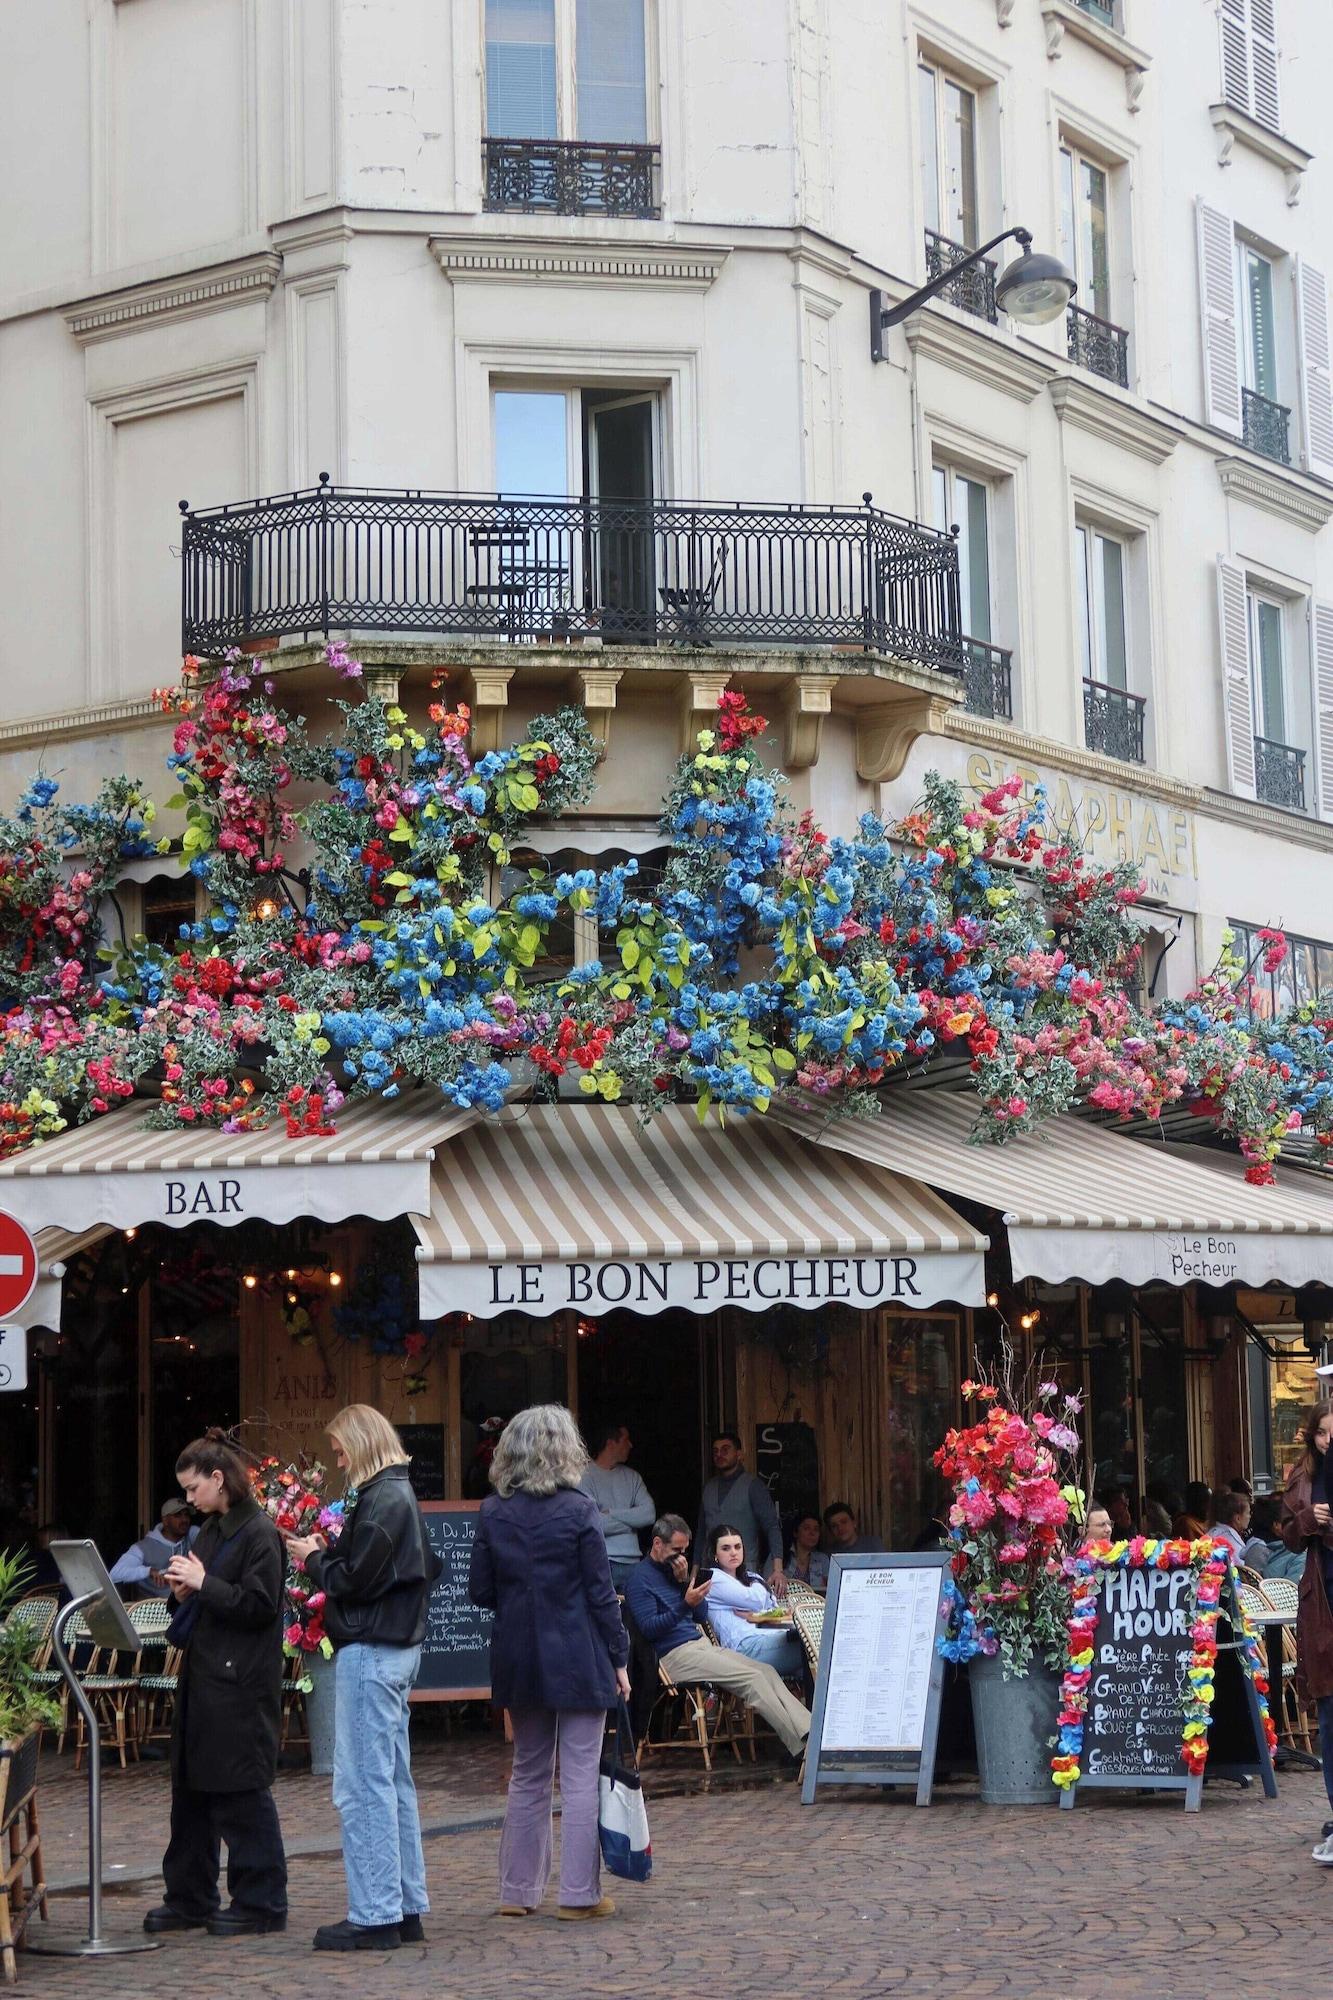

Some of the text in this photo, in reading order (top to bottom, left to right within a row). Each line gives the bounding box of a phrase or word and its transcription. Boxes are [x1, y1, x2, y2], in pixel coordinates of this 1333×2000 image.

[165, 1180, 244, 1215] BAR
[1183, 1236, 1236, 1254] Le Bon
[1171, 1254, 1237, 1277] Pecheur
[488, 1257, 921, 1304] LE BON PECHEUR
[443, 1522, 458, 1538] Du
[462, 1521, 476, 1539] Jo
